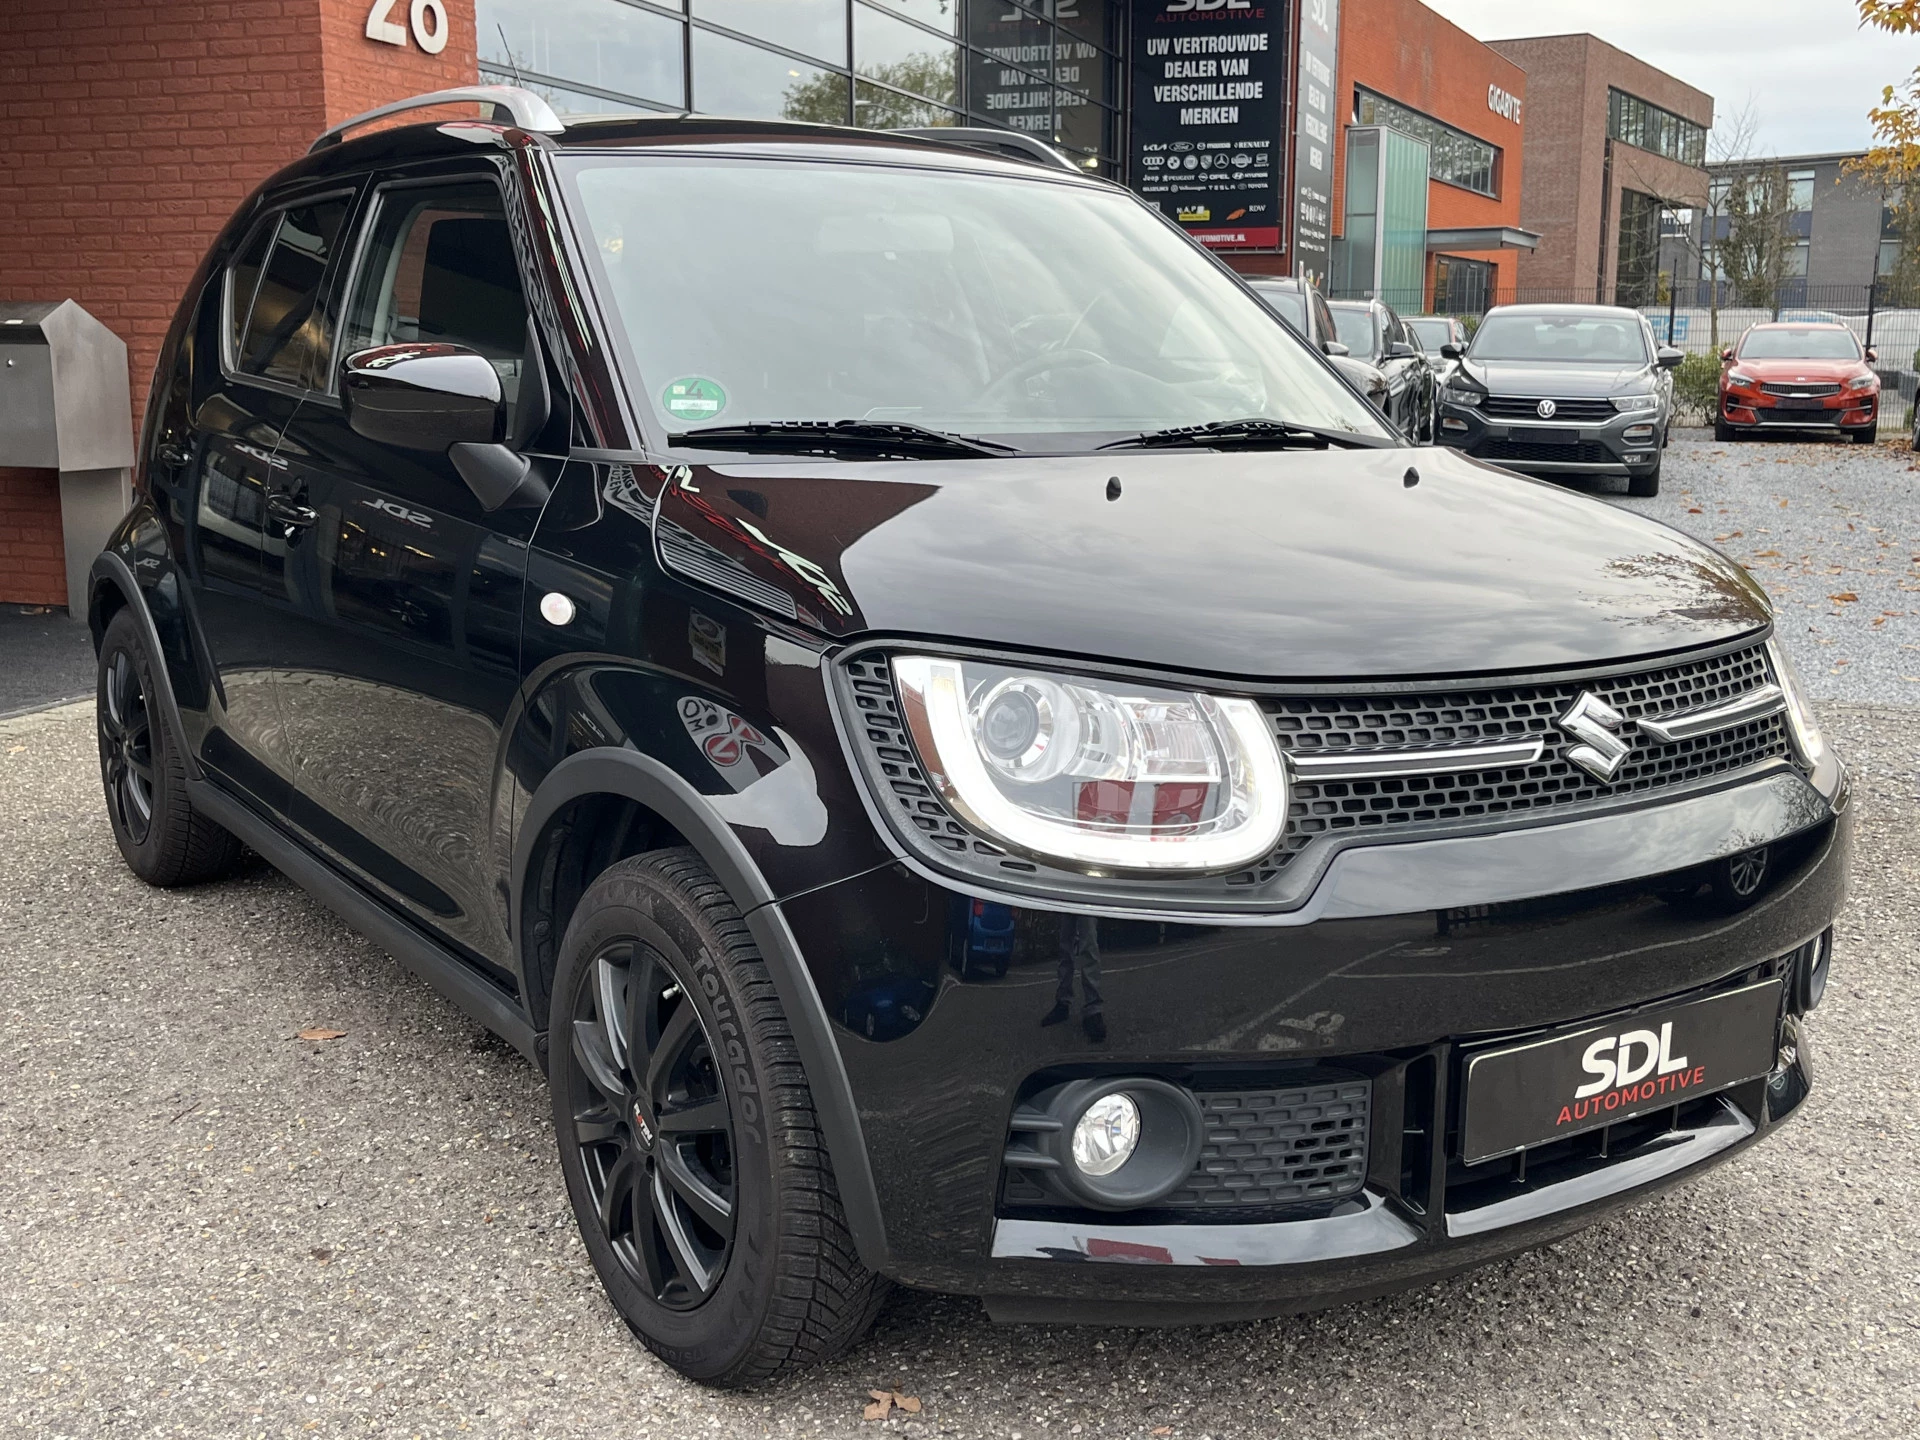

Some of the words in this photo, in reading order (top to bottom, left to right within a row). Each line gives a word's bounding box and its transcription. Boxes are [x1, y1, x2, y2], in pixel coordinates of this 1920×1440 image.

[1155, 8, 1265, 22] AUTOMOTIVE
[1147, 38, 1170, 56] UW
[1173, 33, 1268, 54] VERTROUWDE
[1164, 61, 1217, 78] DEALER
[1220, 58, 1249, 76] VAN
[1154, 82, 1263, 102] VERSCHILLENDE
[1487, 83, 1521, 125] GIGABYTE
[1180, 107, 1239, 125] MERKEN
[1574, 1021, 1688, 1099] SDL
[1556, 1066, 1705, 1126] AUTOMOTIVE
